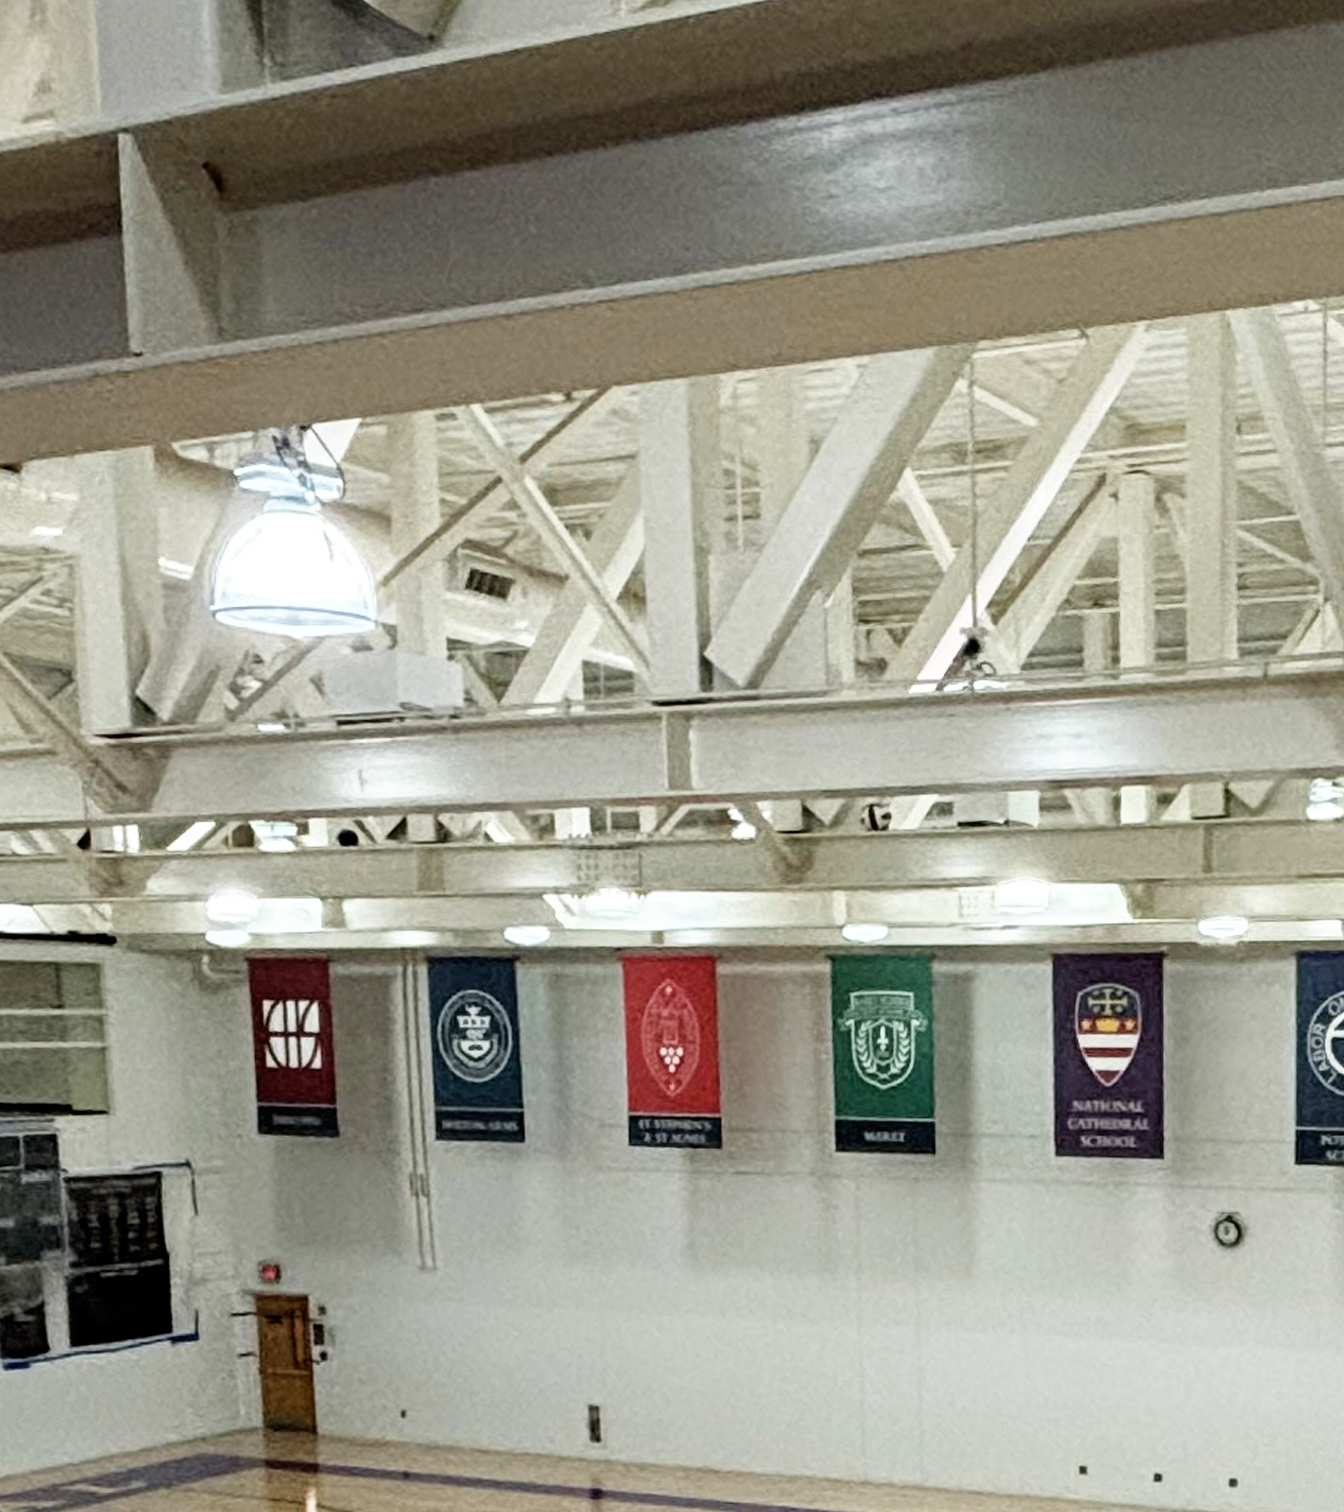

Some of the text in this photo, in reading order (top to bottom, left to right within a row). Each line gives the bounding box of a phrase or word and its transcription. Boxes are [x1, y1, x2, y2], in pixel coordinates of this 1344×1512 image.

[1071, 1100, 1145, 1113] NATIONAL
[1067, 1117, 1151, 1131] CATHEDRAL
[1080, 1135, 1138, 1148] SCHOOL
